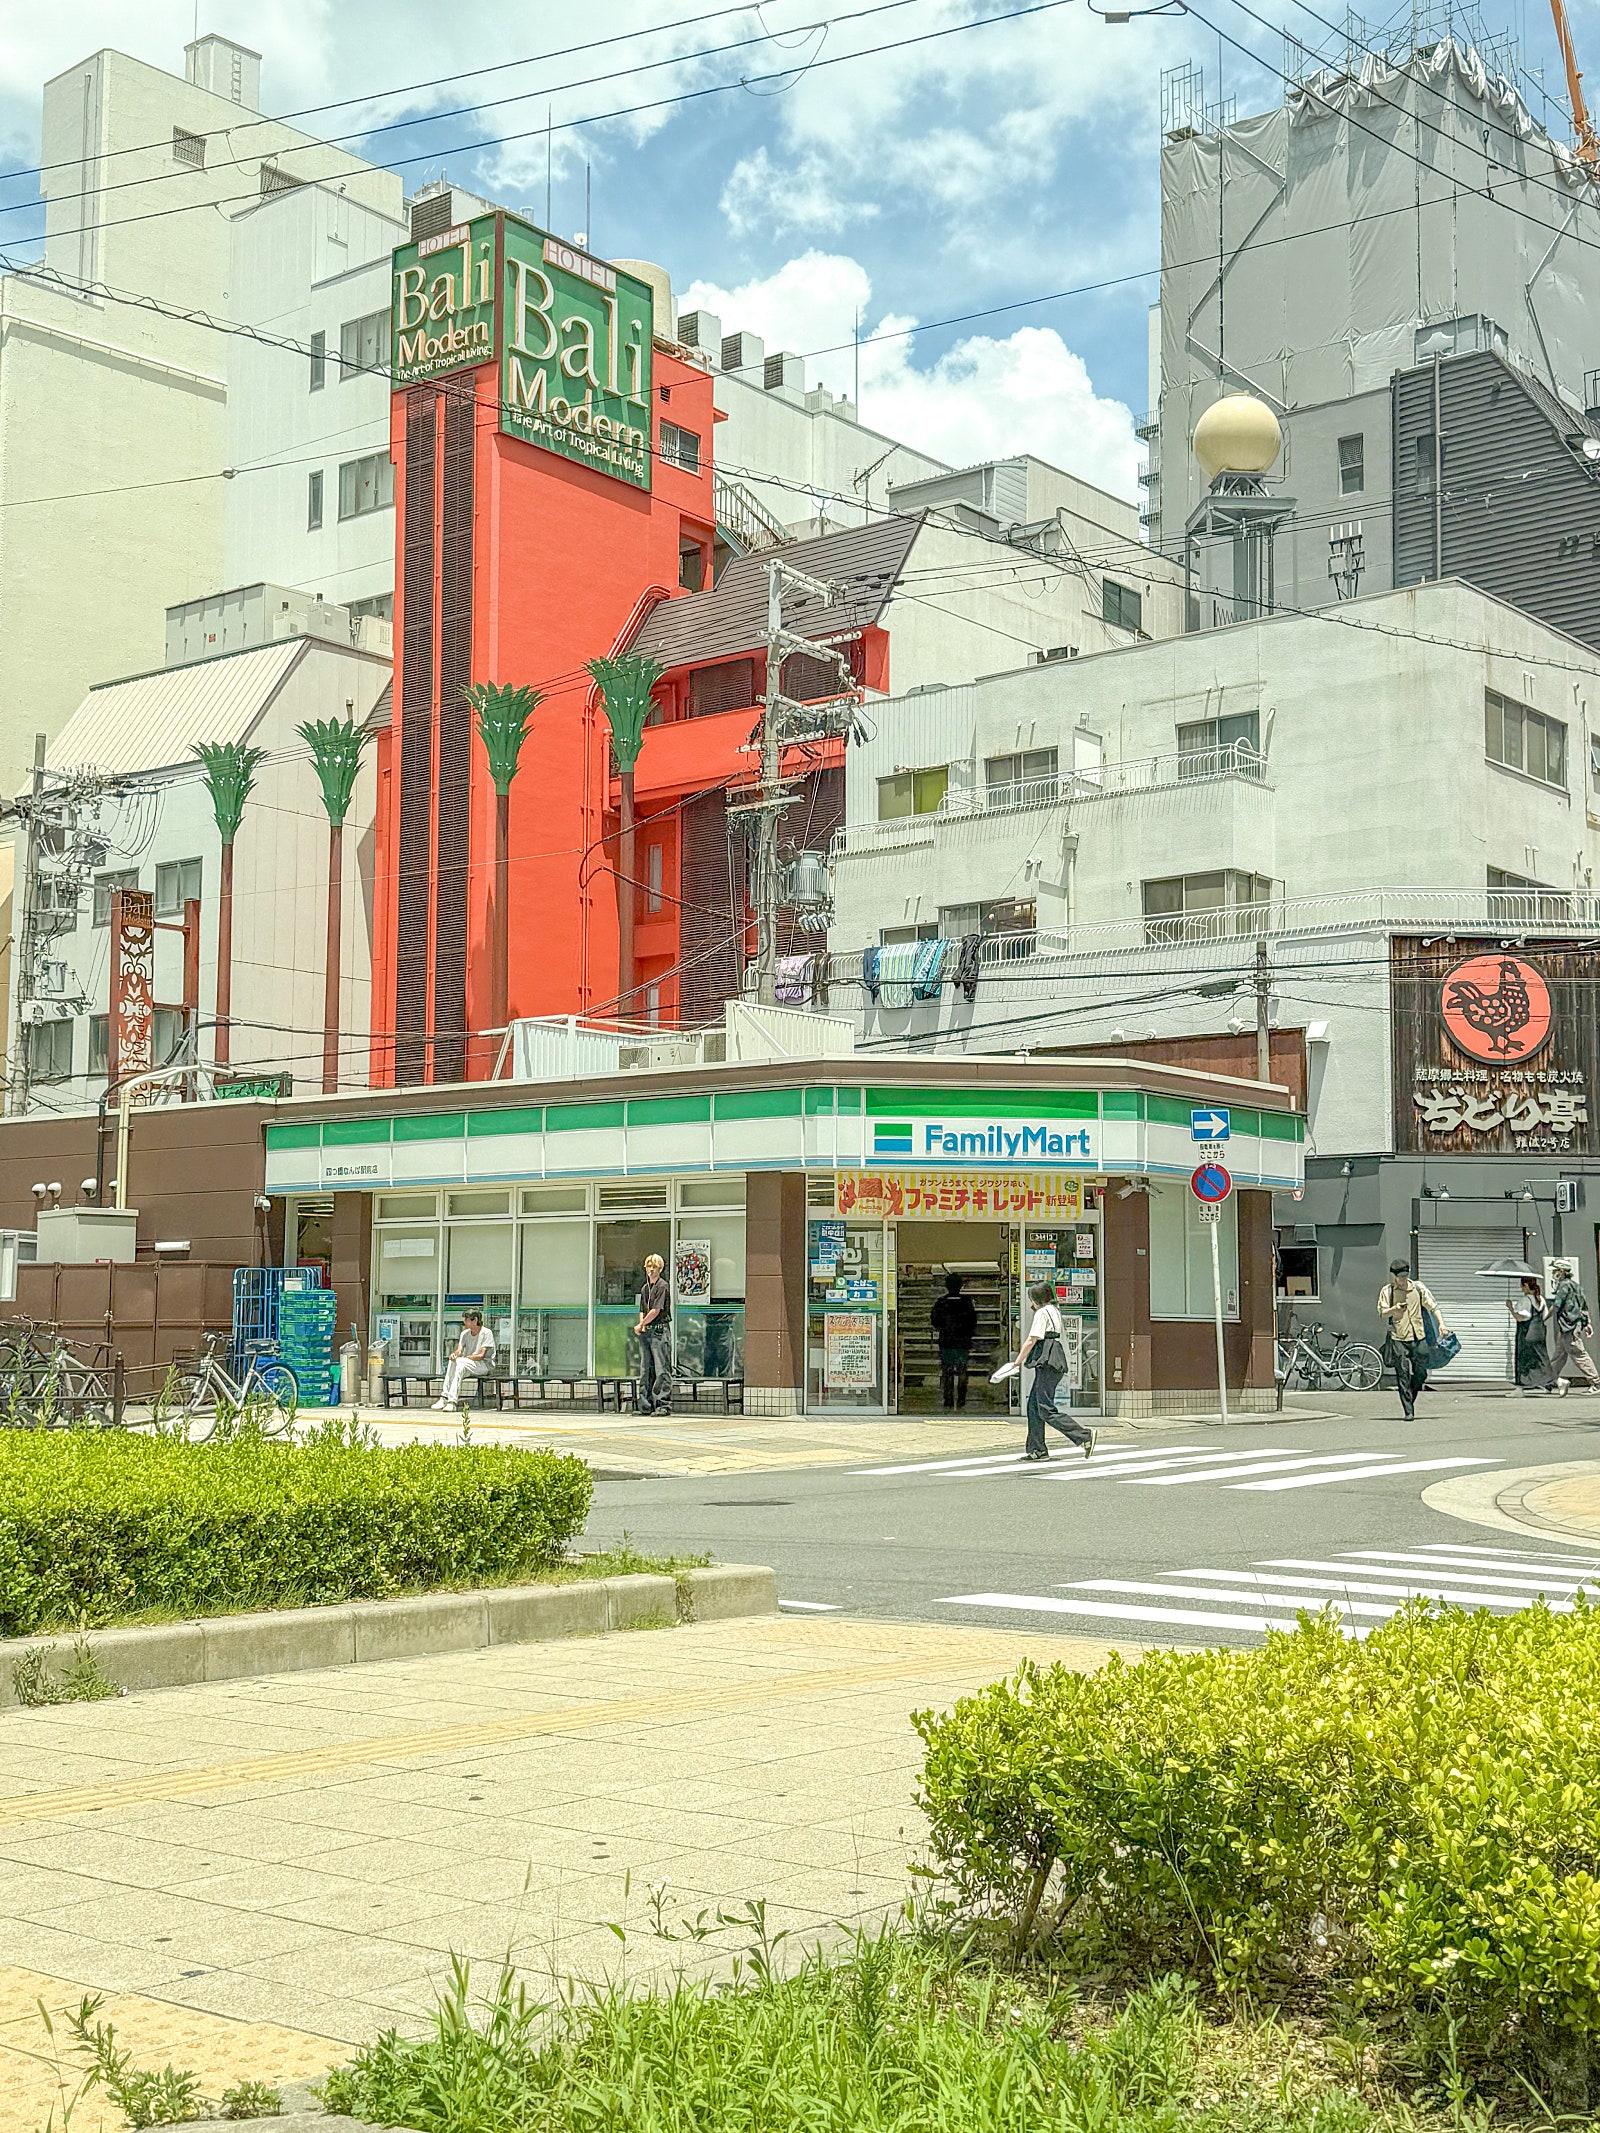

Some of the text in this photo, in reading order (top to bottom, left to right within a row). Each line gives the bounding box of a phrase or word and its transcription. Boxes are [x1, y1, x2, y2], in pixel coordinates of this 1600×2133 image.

[419, 226, 467, 255] HOTEL
[394, 241, 495, 333] Bali
[547, 241, 616, 290] HOTEL
[398, 318, 489, 368] Modern
[506, 256, 648, 409] Bali
[411, 366, 426, 376] Art
[433, 349, 466, 368] Tropical
[466, 345, 491, 359] Living
[508, 355, 644, 460] Modern
[510, 408, 644, 479] The Art of Tropical Living
[123, 896, 151, 917] Bali
[925, 1124, 1090, 1157] FamilyMart
[905, 1188, 1078, 1211] ファミチキレッド 新登場
